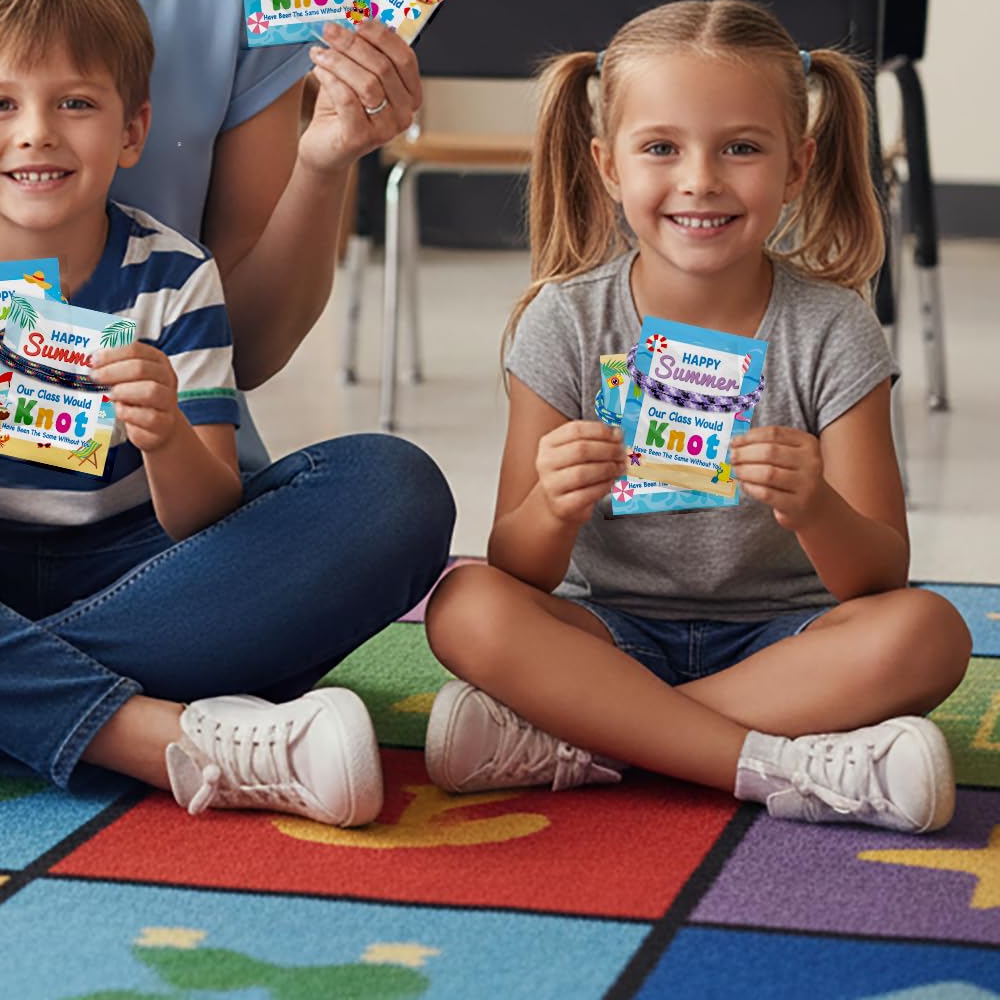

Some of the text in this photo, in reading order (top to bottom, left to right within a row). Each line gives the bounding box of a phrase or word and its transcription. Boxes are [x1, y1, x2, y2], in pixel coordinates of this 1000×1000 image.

[51, 329, 90, 348] HAPPY
[654, 354, 740, 391] Summer
[682, 352, 721, 370] HAPPY
[16, 384, 92, 410] Our Class Would
[14, 397, 89, 438] Knot
[648, 407, 724, 432] Our Class Would
[2, 423, 15, 431] Have
[16, 426, 30, 434] Been
[31, 429, 41, 437] The
[42, 432, 57, 440] Same
[58, 435, 80, 445] Without
[645, 420, 721, 460] Knot
[634, 446, 647, 454] Have
[648, 448, 661, 456] Been
[662, 451, 673, 459] The
[674, 454, 689, 462] Same
[690, 457, 711, 467] Without
